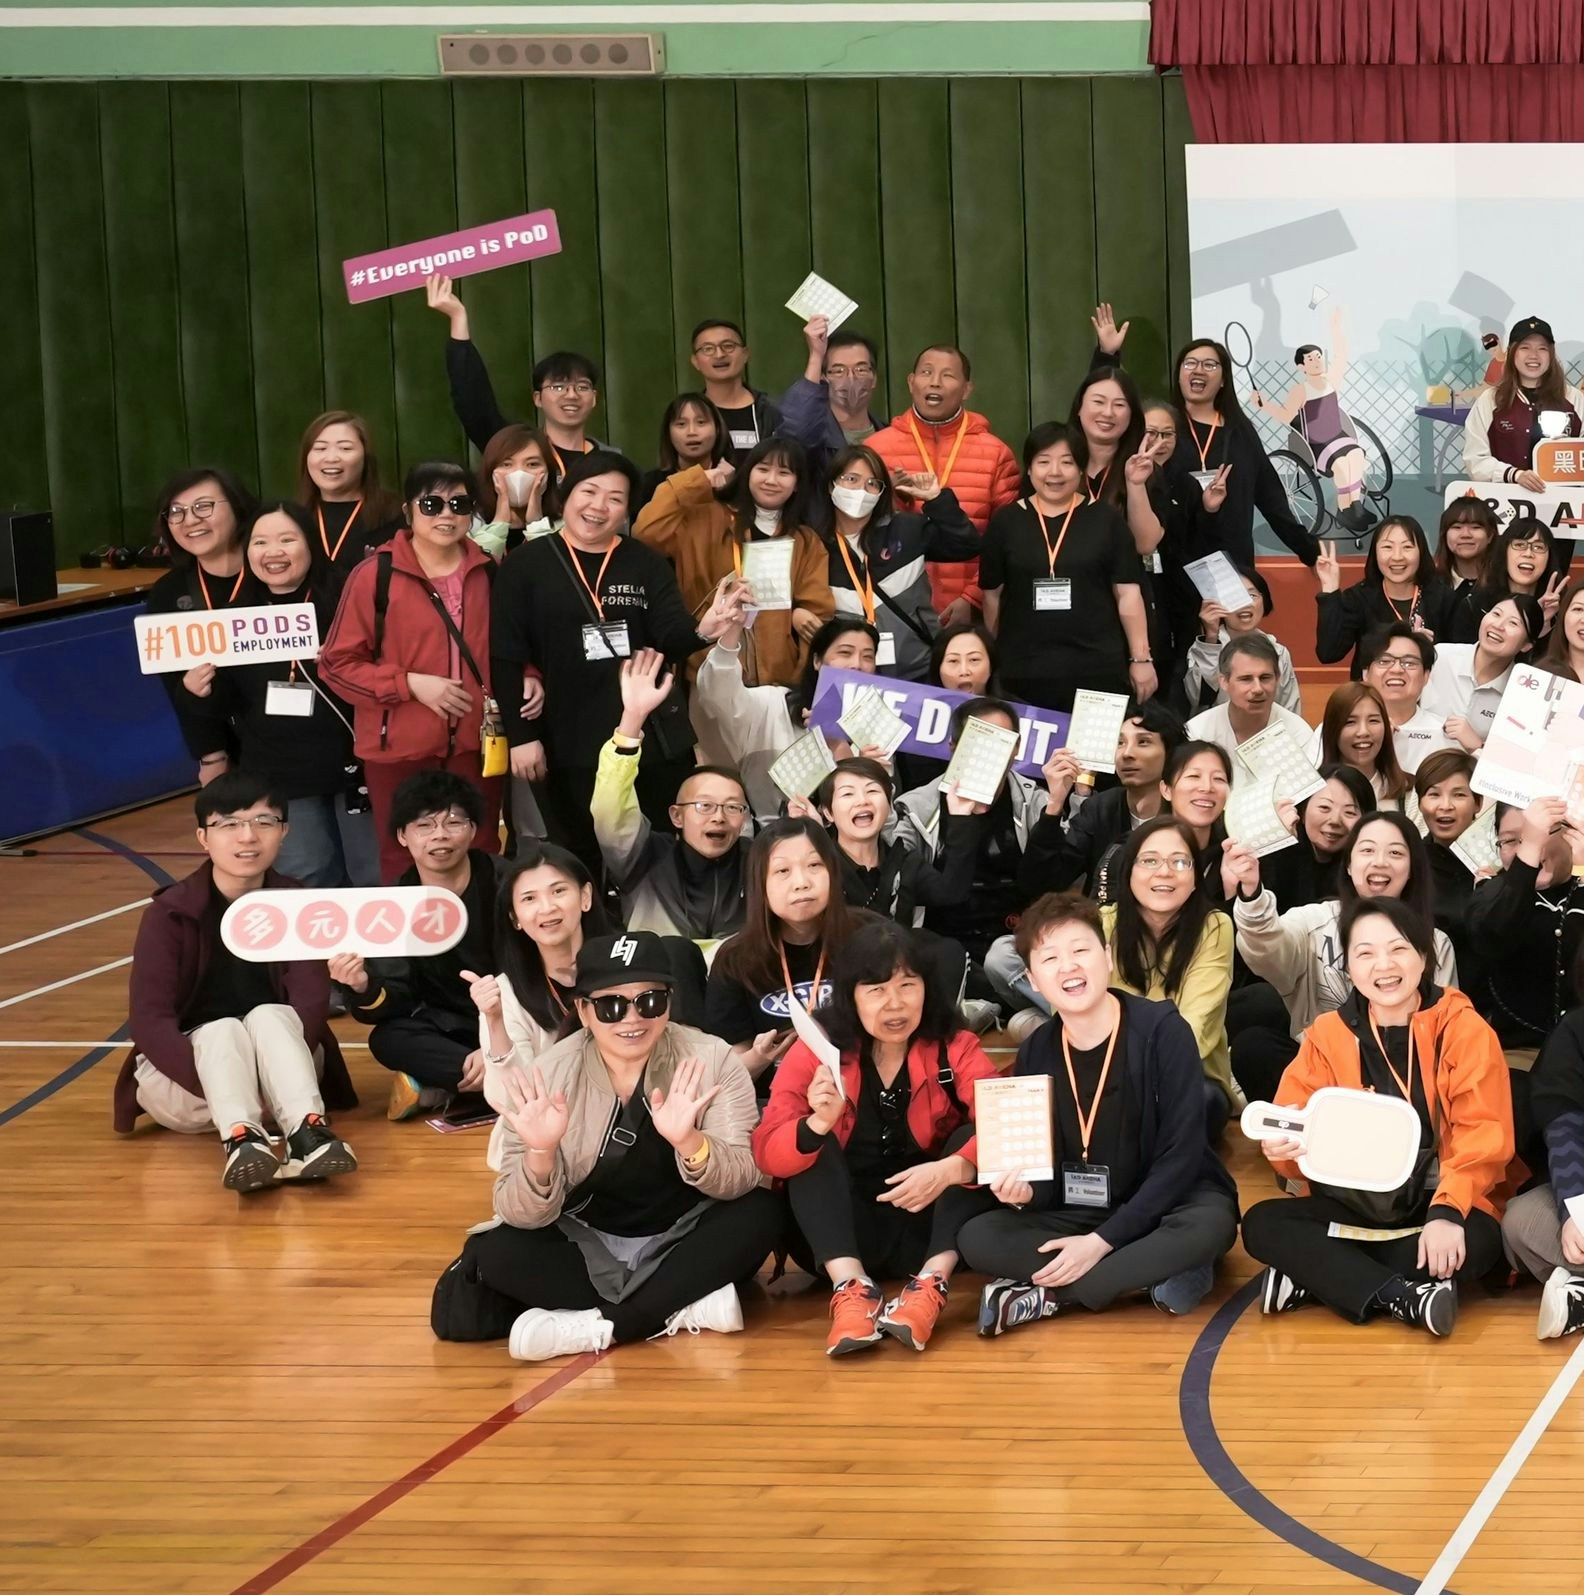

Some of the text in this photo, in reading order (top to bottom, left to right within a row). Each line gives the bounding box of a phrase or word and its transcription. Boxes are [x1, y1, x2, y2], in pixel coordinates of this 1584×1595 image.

[350, 224, 548, 287] #Everyone is PoD
[144, 613, 312, 661] #100 PODS
[233, 634, 313, 653] EMPLOYMENT
[1407, 732, 1432, 740] AECOM
[246, 905, 447, 942] 多元人才
